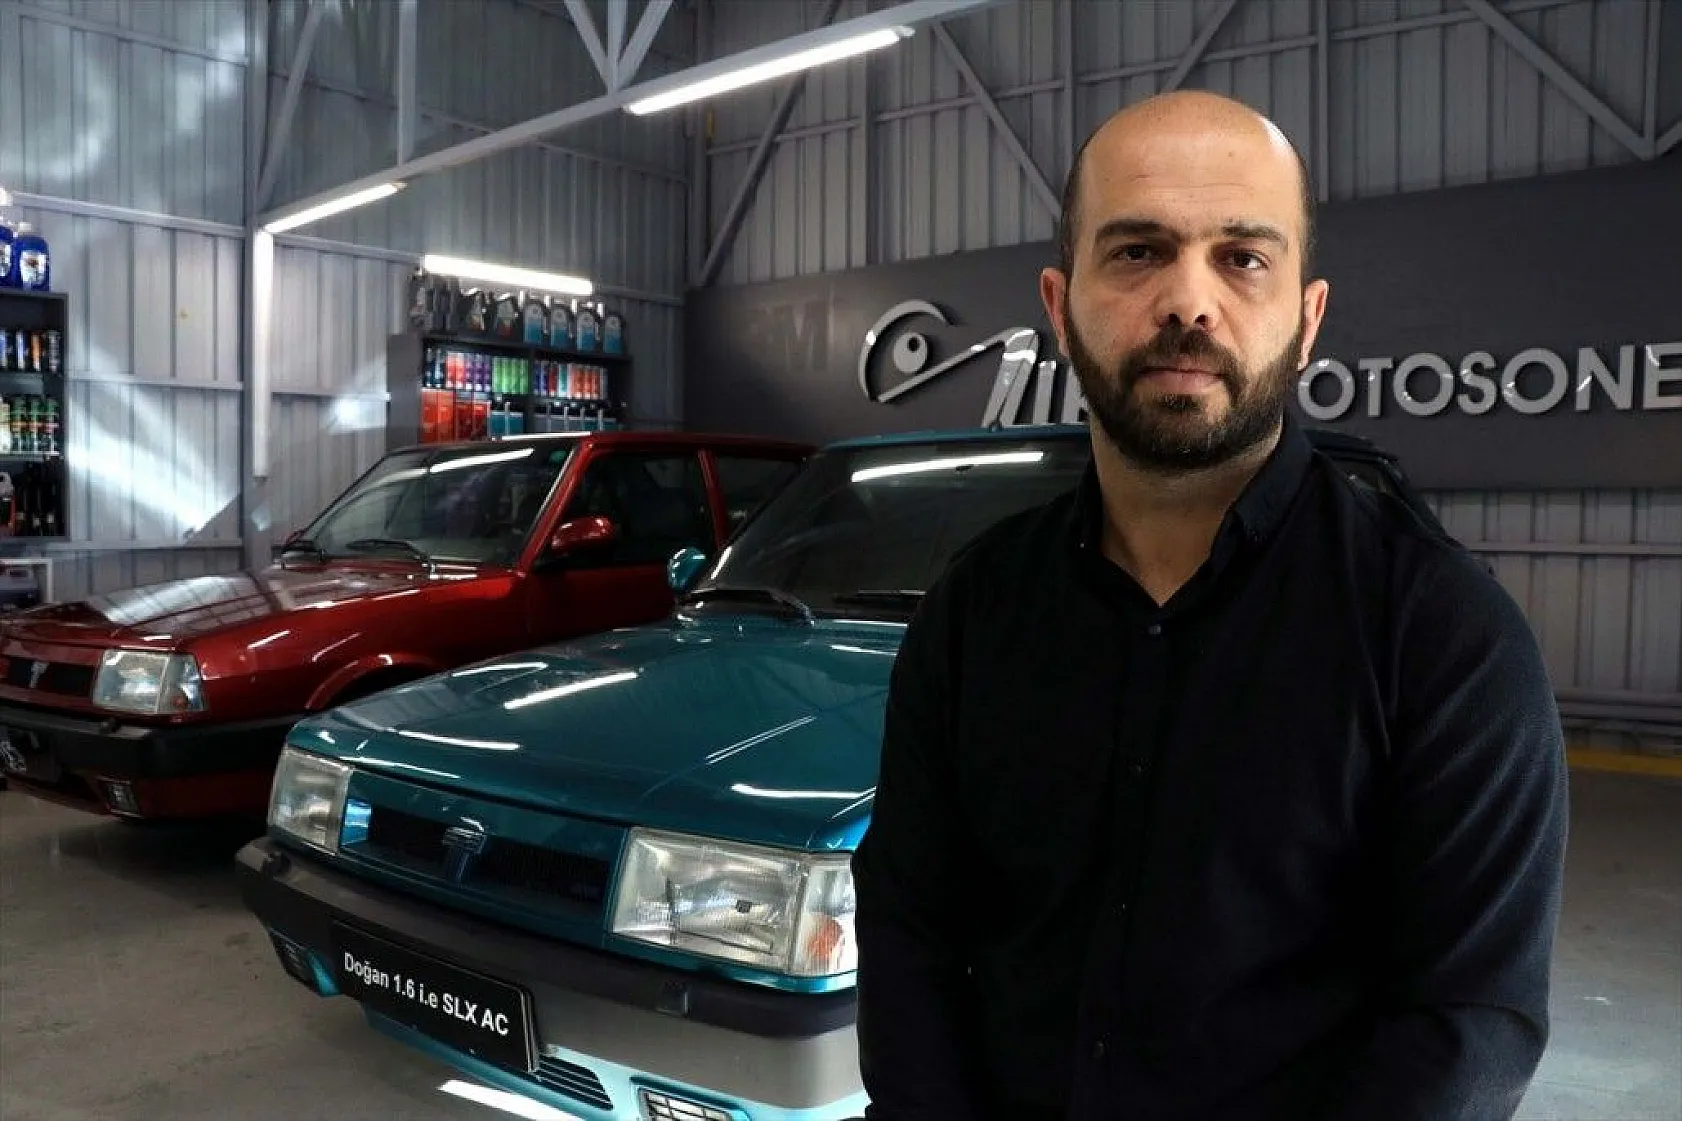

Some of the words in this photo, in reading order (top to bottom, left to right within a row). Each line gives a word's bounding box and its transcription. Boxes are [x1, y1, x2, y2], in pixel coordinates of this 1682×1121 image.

[344, 952, 389, 988] Doğan
[393, 973, 416, 999] 1.6
[419, 983, 438, 1009] i.e
[442, 993, 478, 1024] SLX
[481, 1008, 509, 1036] AC
